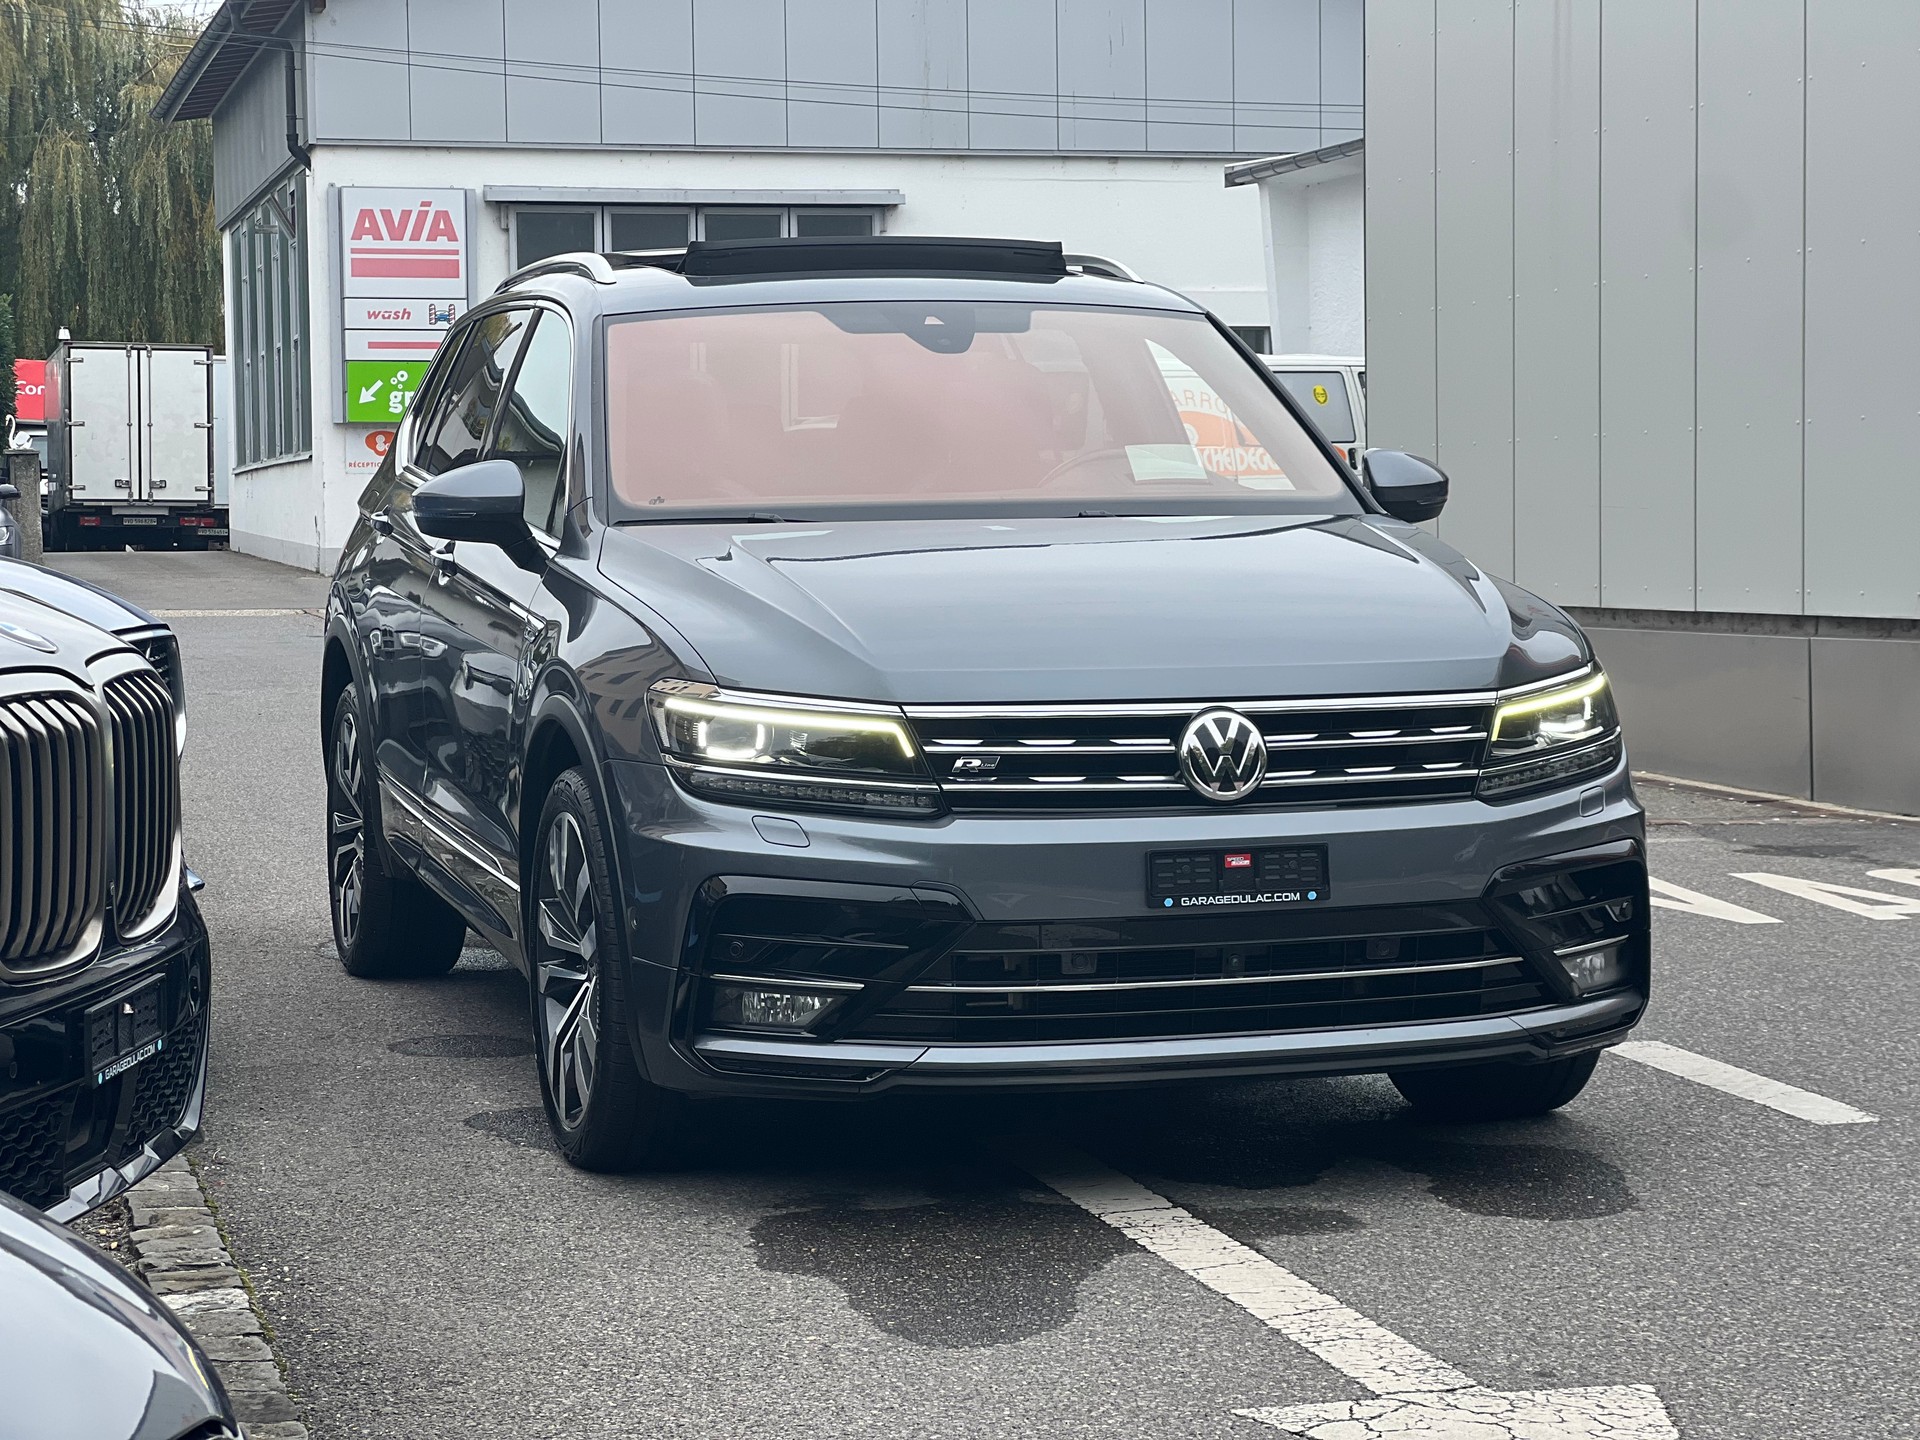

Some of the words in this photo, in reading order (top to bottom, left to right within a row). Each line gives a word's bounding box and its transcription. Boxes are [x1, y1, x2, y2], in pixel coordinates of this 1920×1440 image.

[350, 200, 460, 242] AVIA
[367, 308, 412, 320] wash
[1180, 892, 1301, 906] GARAGEDULAC.COM
